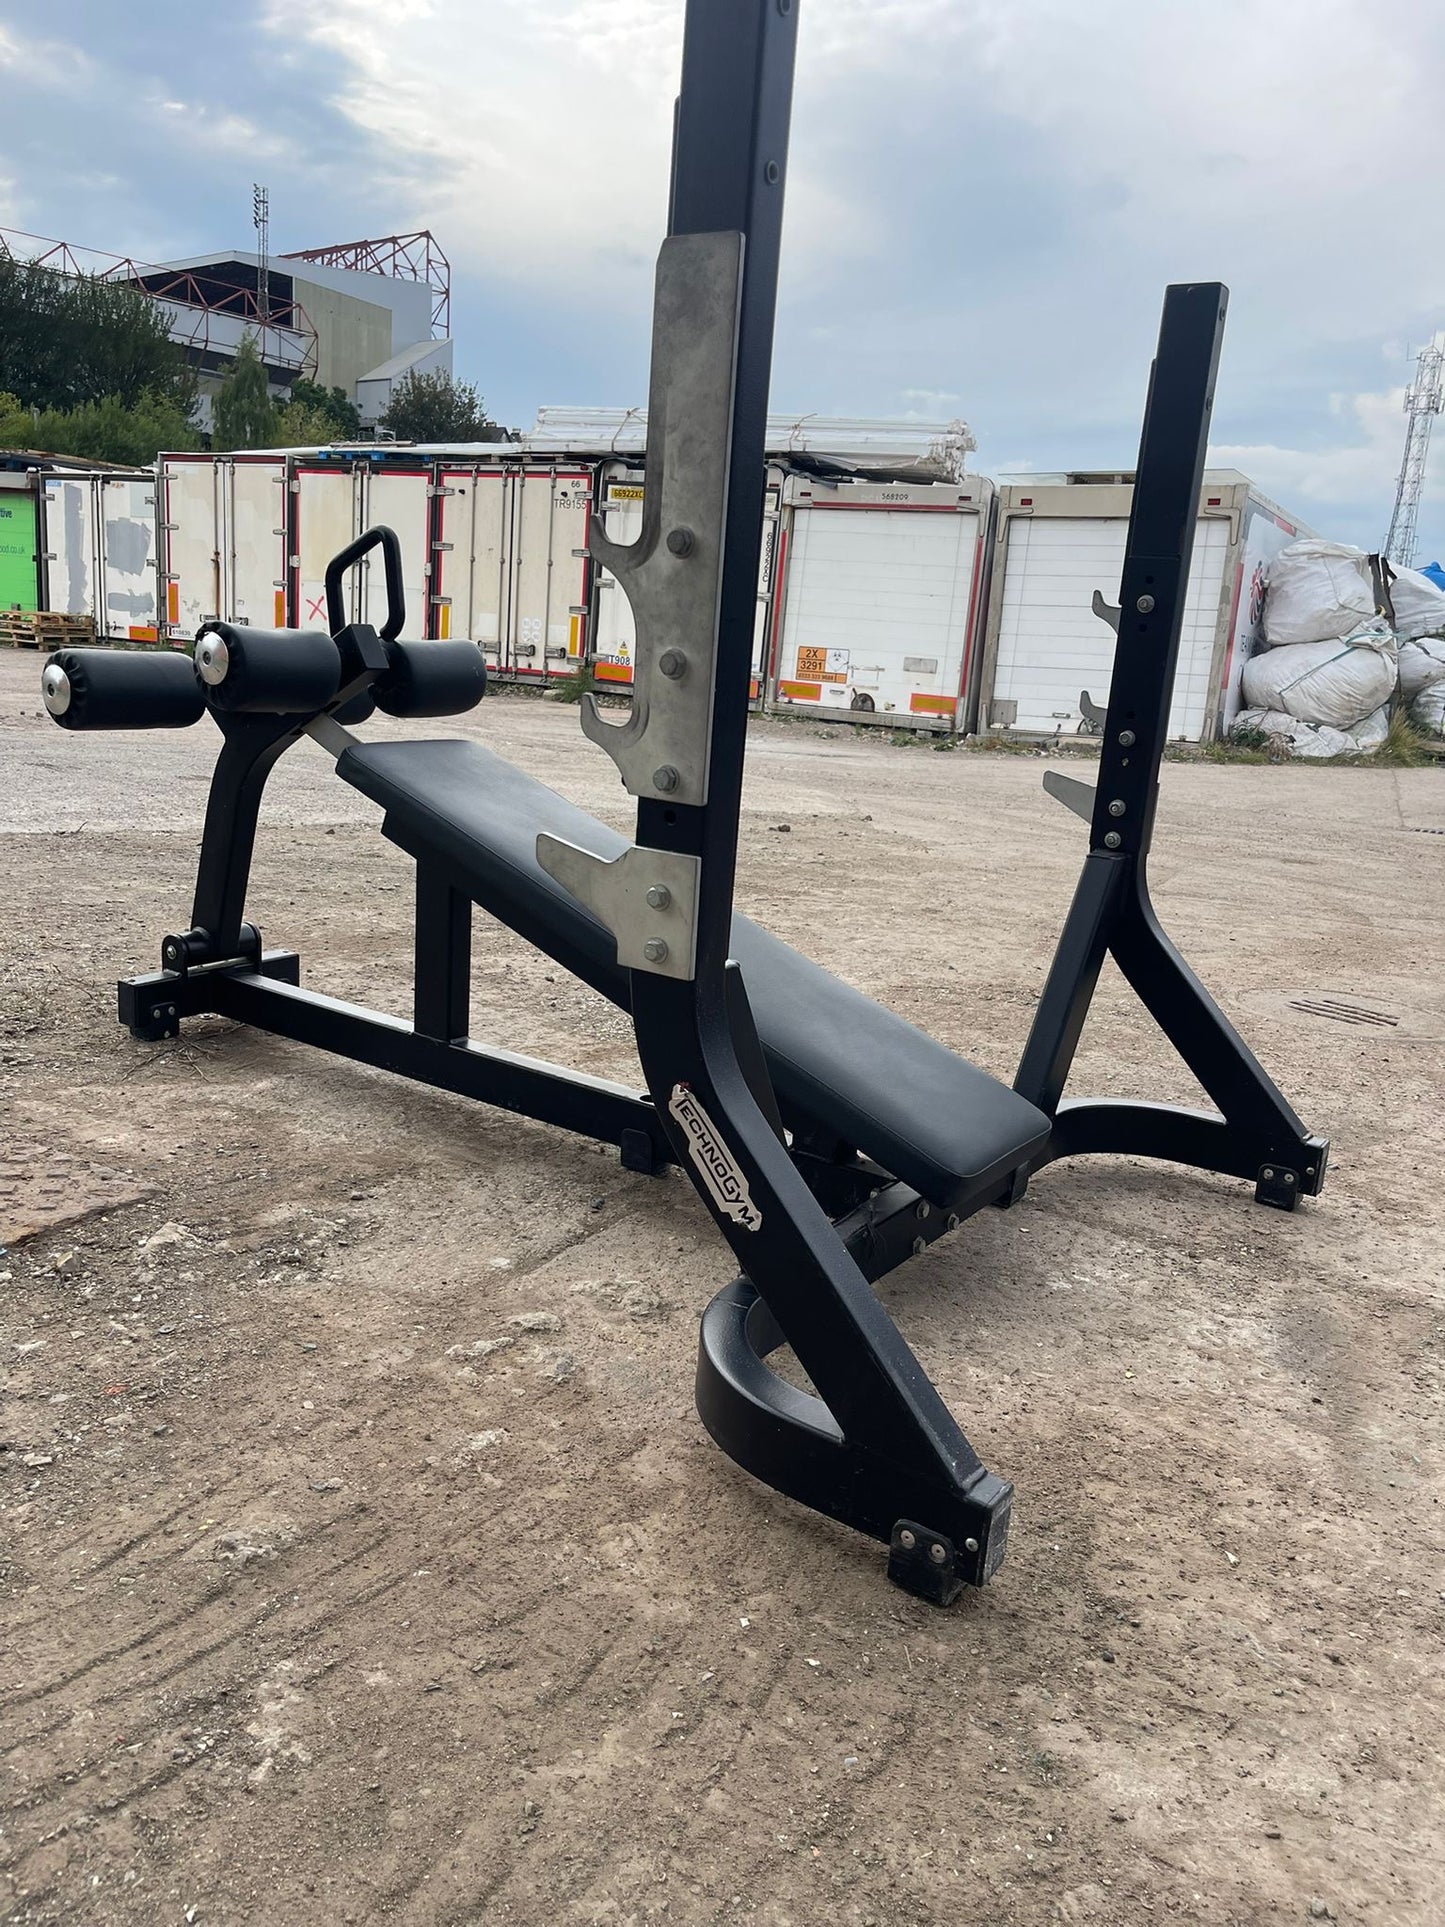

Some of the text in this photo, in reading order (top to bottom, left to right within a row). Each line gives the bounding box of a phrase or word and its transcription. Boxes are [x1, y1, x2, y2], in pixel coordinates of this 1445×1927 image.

[554, 499, 587, 510] TR9155
[805, 649, 818, 658] 2X
[800, 660, 822, 670] 3291
[674, 1099, 755, 1226] TECHNOGYM
